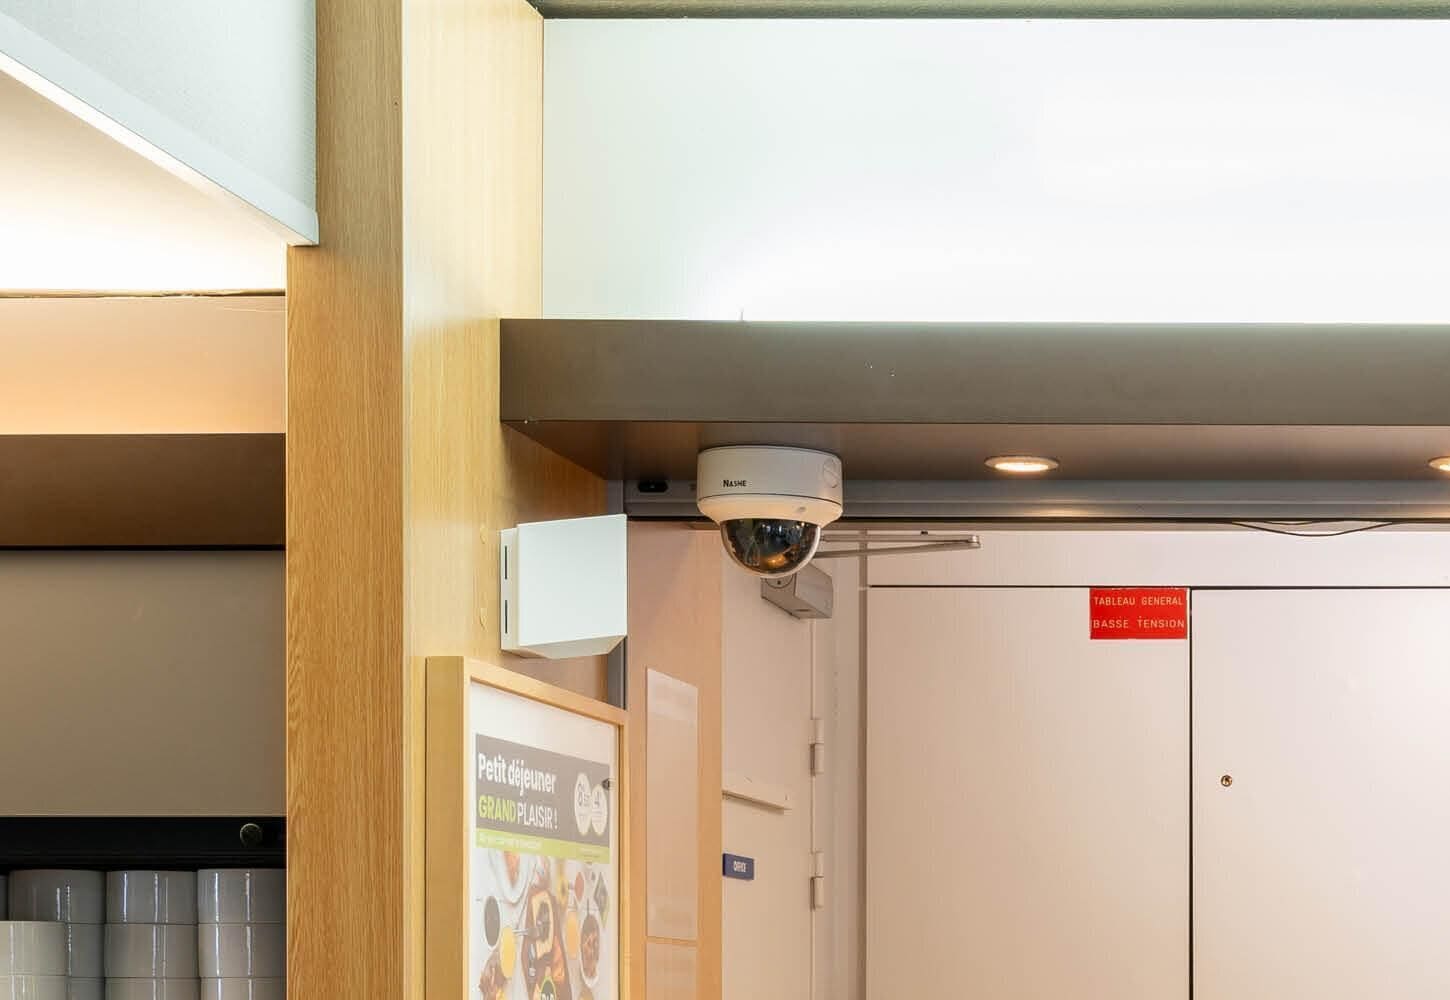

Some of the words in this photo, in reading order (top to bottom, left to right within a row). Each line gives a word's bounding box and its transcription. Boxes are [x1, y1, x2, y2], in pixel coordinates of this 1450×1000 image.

[1094, 596, 1136, 606] TABLEAU
[1141, 596, 1184, 606] GENERAL
[1093, 619, 1129, 629] BASSE
[1137, 619, 1185, 629] TENSION
[478, 752, 507, 784] Petit
[507, 758, 558, 797] déjeuner
[479, 794, 517, 823] GRAND
[517, 802, 554, 830] PLAISIR
